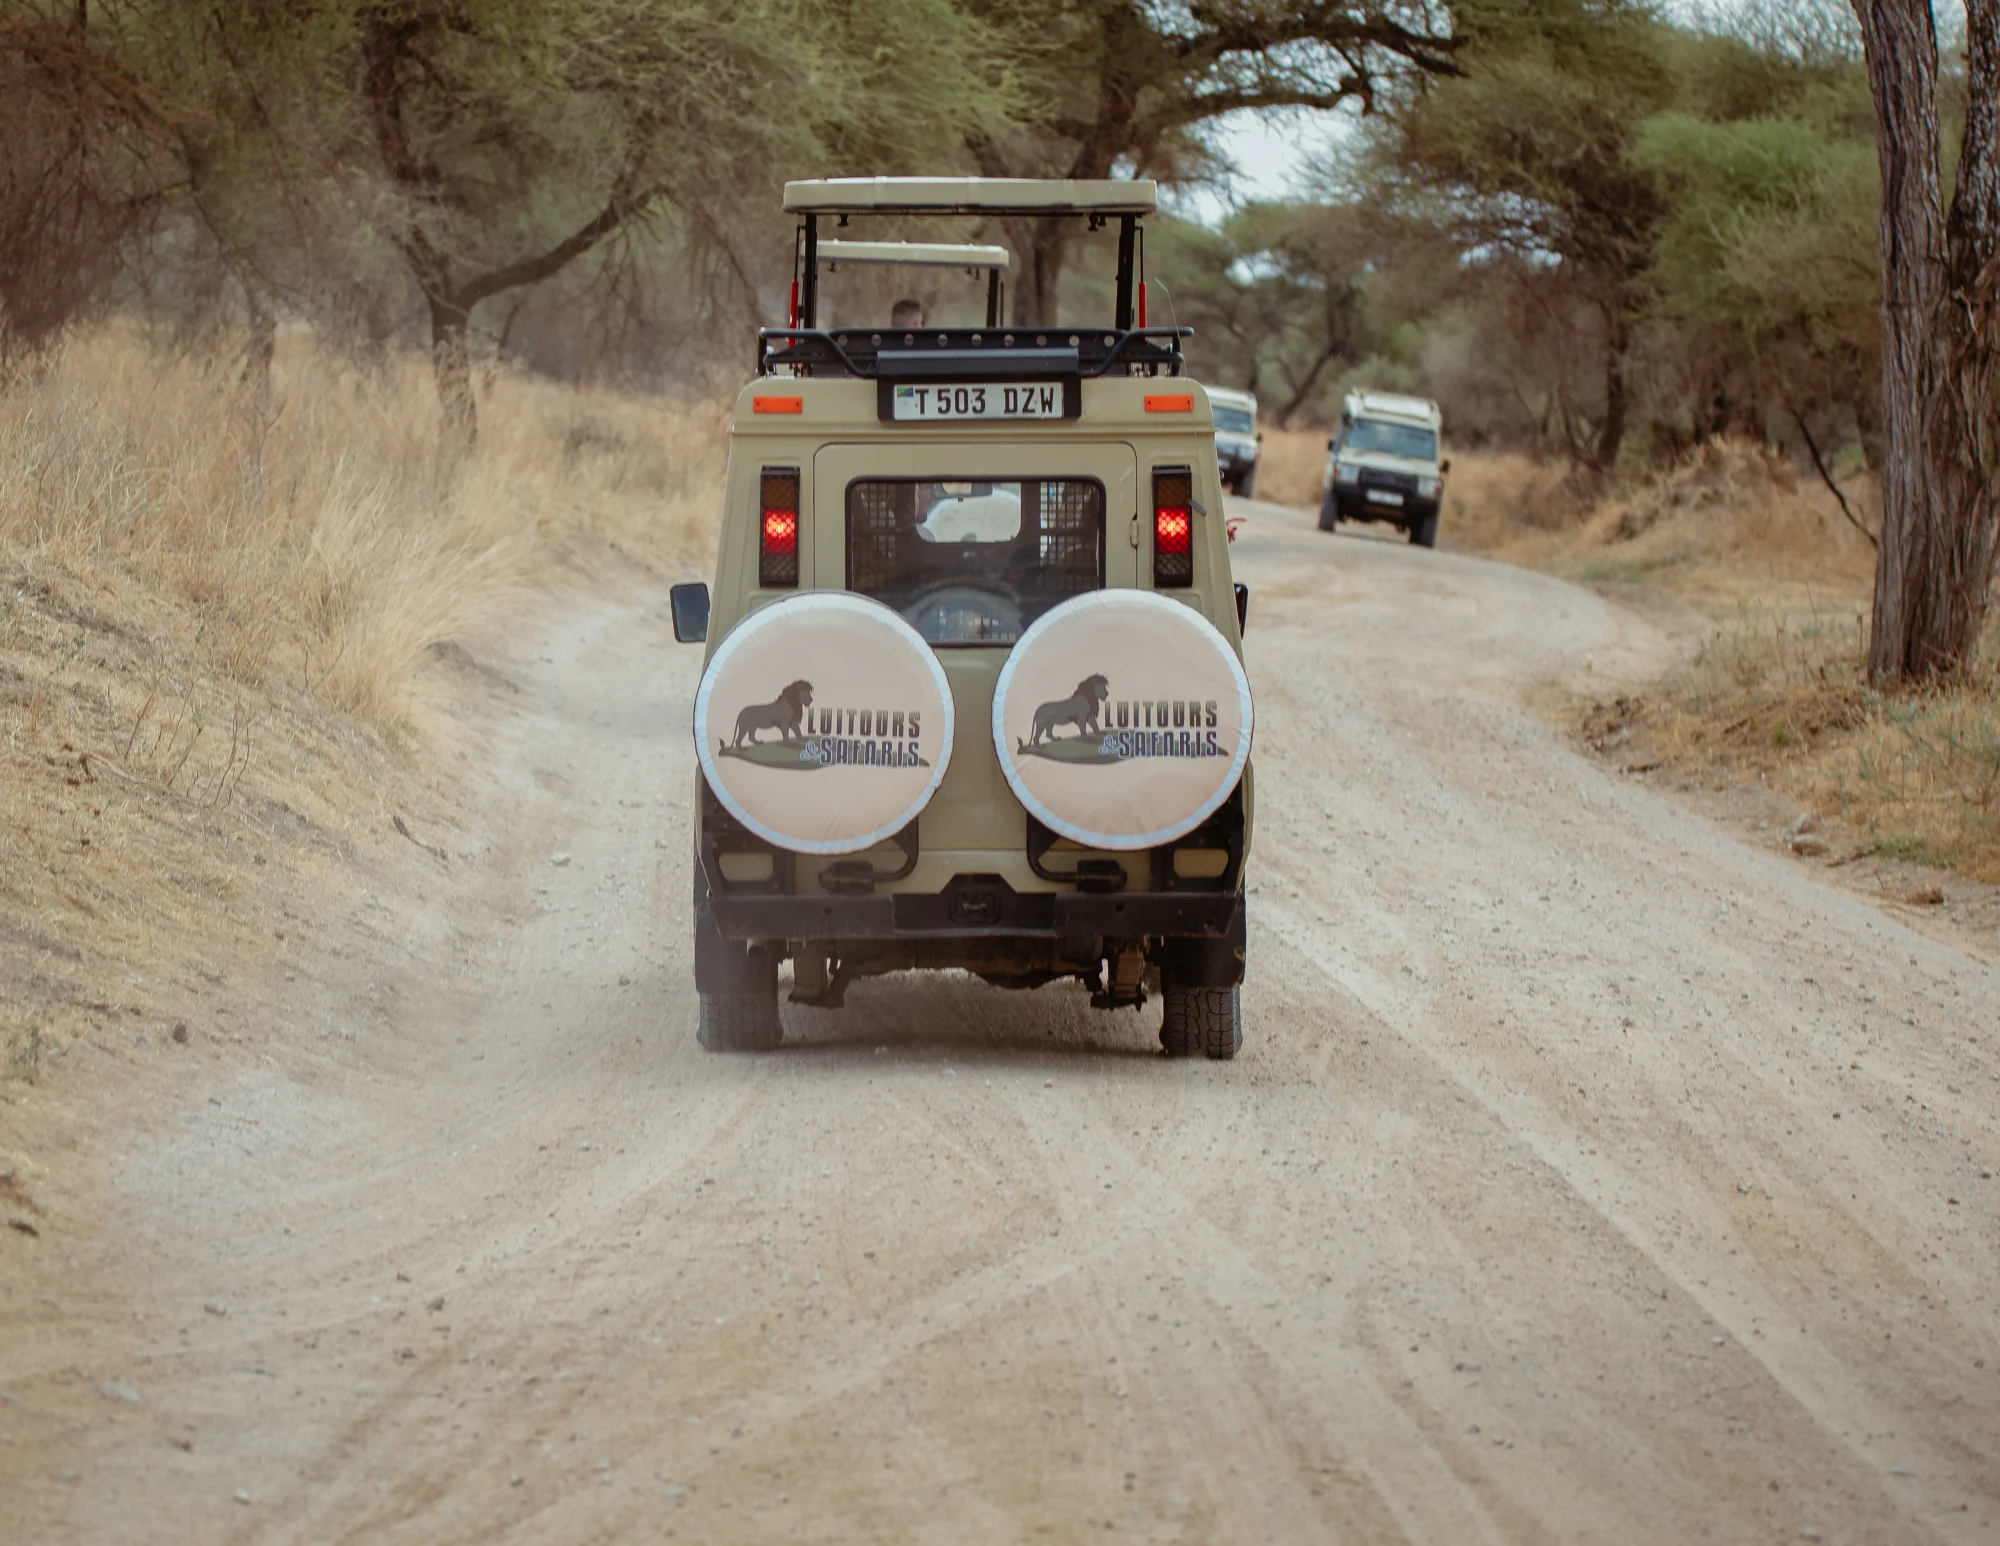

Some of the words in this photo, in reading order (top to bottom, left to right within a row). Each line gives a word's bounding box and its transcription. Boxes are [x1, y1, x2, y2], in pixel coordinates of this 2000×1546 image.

[914, 388, 930, 415] T
[937, 388, 986, 414] 503
[1003, 387, 1054, 414] DZW
[807, 708, 921, 738] LUITOURS
[1104, 701, 1218, 728] LUITOURS
